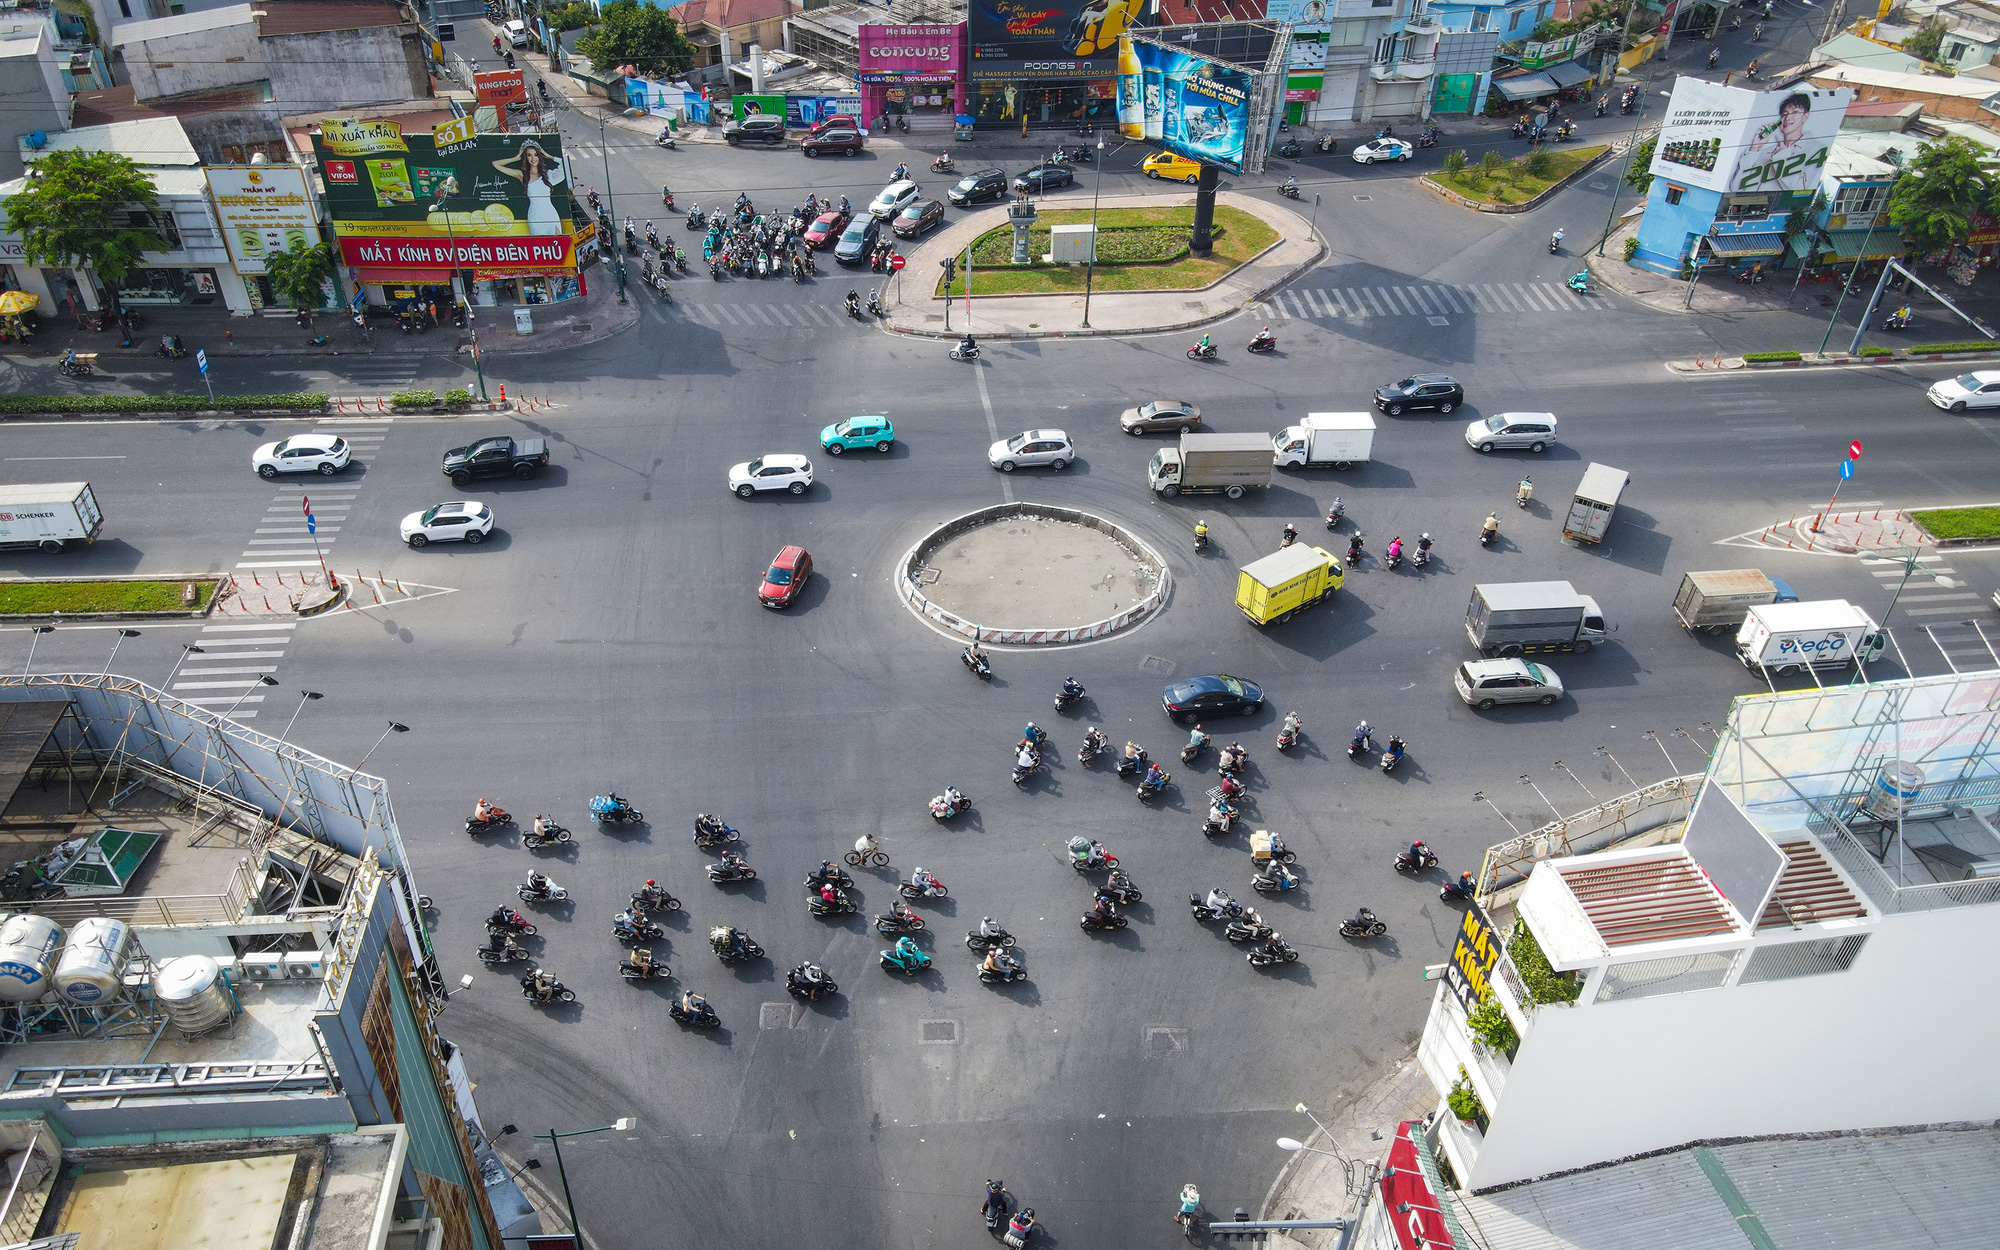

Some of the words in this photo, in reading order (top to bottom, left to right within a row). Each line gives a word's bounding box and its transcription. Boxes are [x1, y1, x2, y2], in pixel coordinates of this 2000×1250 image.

[886, 28, 898, 37] Mẹ
[1034, 27, 1055, 35] THÂN
[869, 44, 951, 61] concung
[478, 79, 522, 90] KINGFOOD
[490, 88, 513, 98] mart
[1199, 77, 1225, 92] THÙNG
[1225, 86, 1246, 99] CHILL
[1187, 82, 1200, 93] TỚI
[1200, 87, 1217, 99] MÙA
[1218, 93, 1239, 106] CHILL
[326, 130, 338, 141] MÌ
[340, 127, 365, 142] XUẤT
[369, 124, 397, 139] KHẨU
[437, 123, 455, 145] SỐ
[456, 120, 468, 138] 1
[449, 145, 459, 153] BA
[460, 142, 477, 152] LAN
[1739, 147, 1828, 190] 2024
[343, 222, 354, 231] 19
[359, 241, 392, 262] MẮT
[397, 244, 431, 262] KÍNH
[458, 244, 492, 264] ĐIỆN
[497, 244, 529, 261] BIÊN
[532, 240, 562, 260] PHỦ
[15, 512, 55, 520] SCHENKER
[1463, 909, 1499, 972] MẮT
[1454, 938, 1489, 1003] KÍNH
